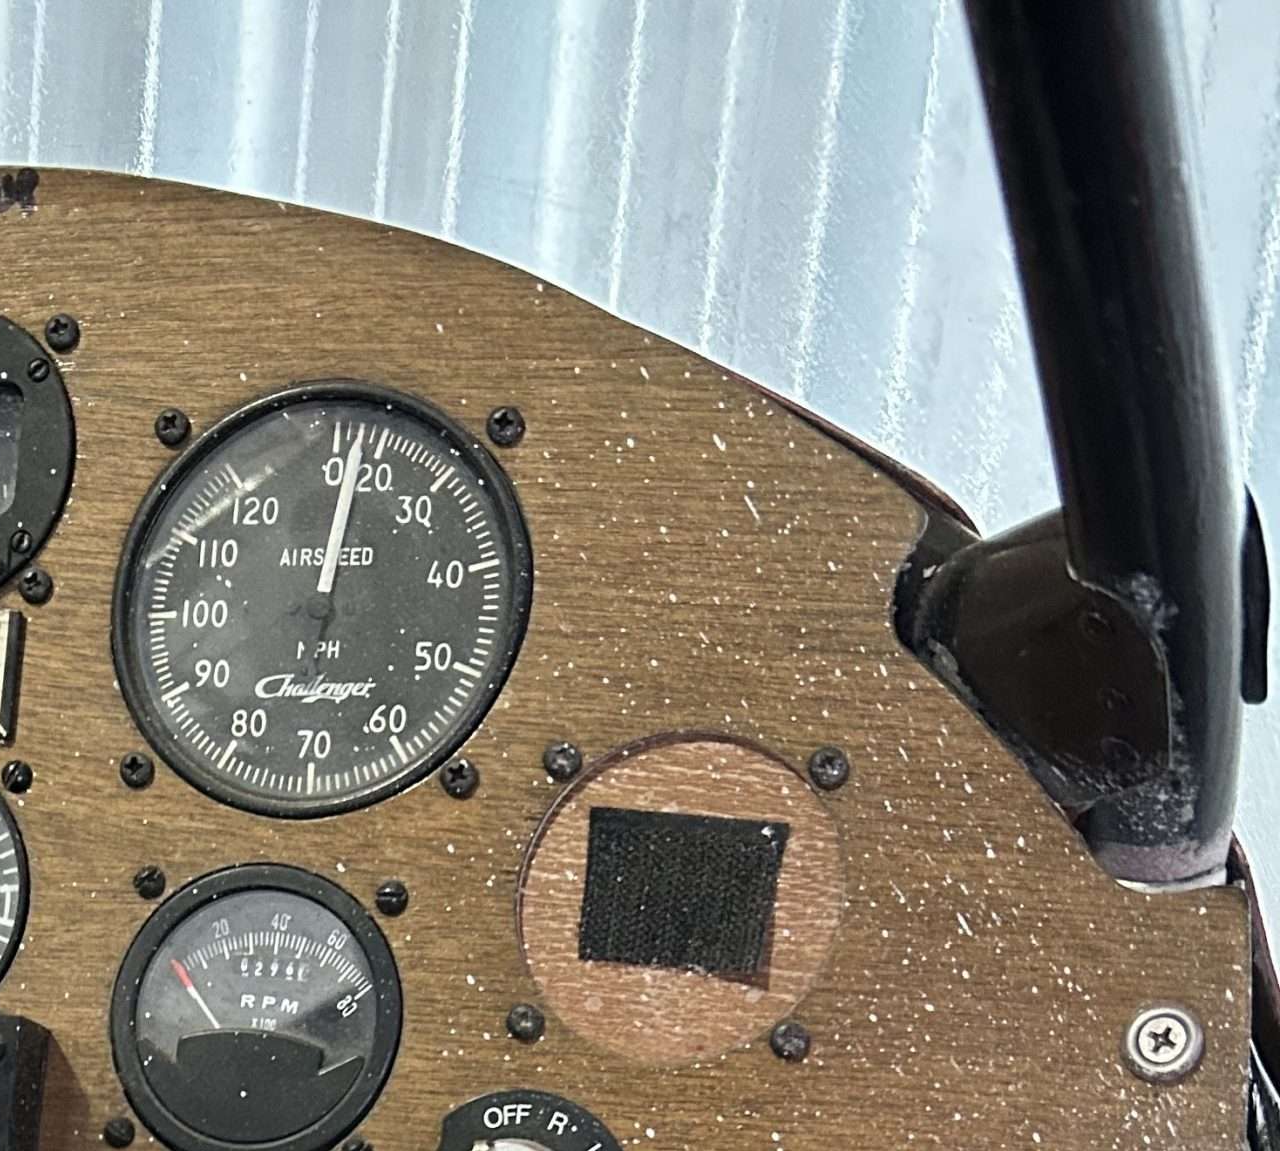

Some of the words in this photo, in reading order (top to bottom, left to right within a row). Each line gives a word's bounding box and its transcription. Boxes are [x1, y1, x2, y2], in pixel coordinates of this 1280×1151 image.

[325, 457, 343, 486] 0
[355, 464, 392, 492] 20
[232, 498, 279, 526] 120
[394, 496, 431, 525] 30
[198, 540, 238, 567] 110
[280, 548, 373, 566] AIRSEED
[427, 561, 462, 588] 40
[182, 601, 228, 627] 100
[415, 642, 451, 671] 50
[194, 660, 229, 688] 90
[255, 672, 376, 704] Challenger
[231, 710, 266, 736] 80
[369, 705, 407, 732] 60
[297, 730, 330, 758] 70
[212, 918, 229, 938] 20
[271, 913, 289, 930] 40
[327, 929, 347, 950] 60
[336, 994, 358, 1018] 80
[483, 1104, 532, 1128] OFF
[547, 1111, 568, 1135] R
